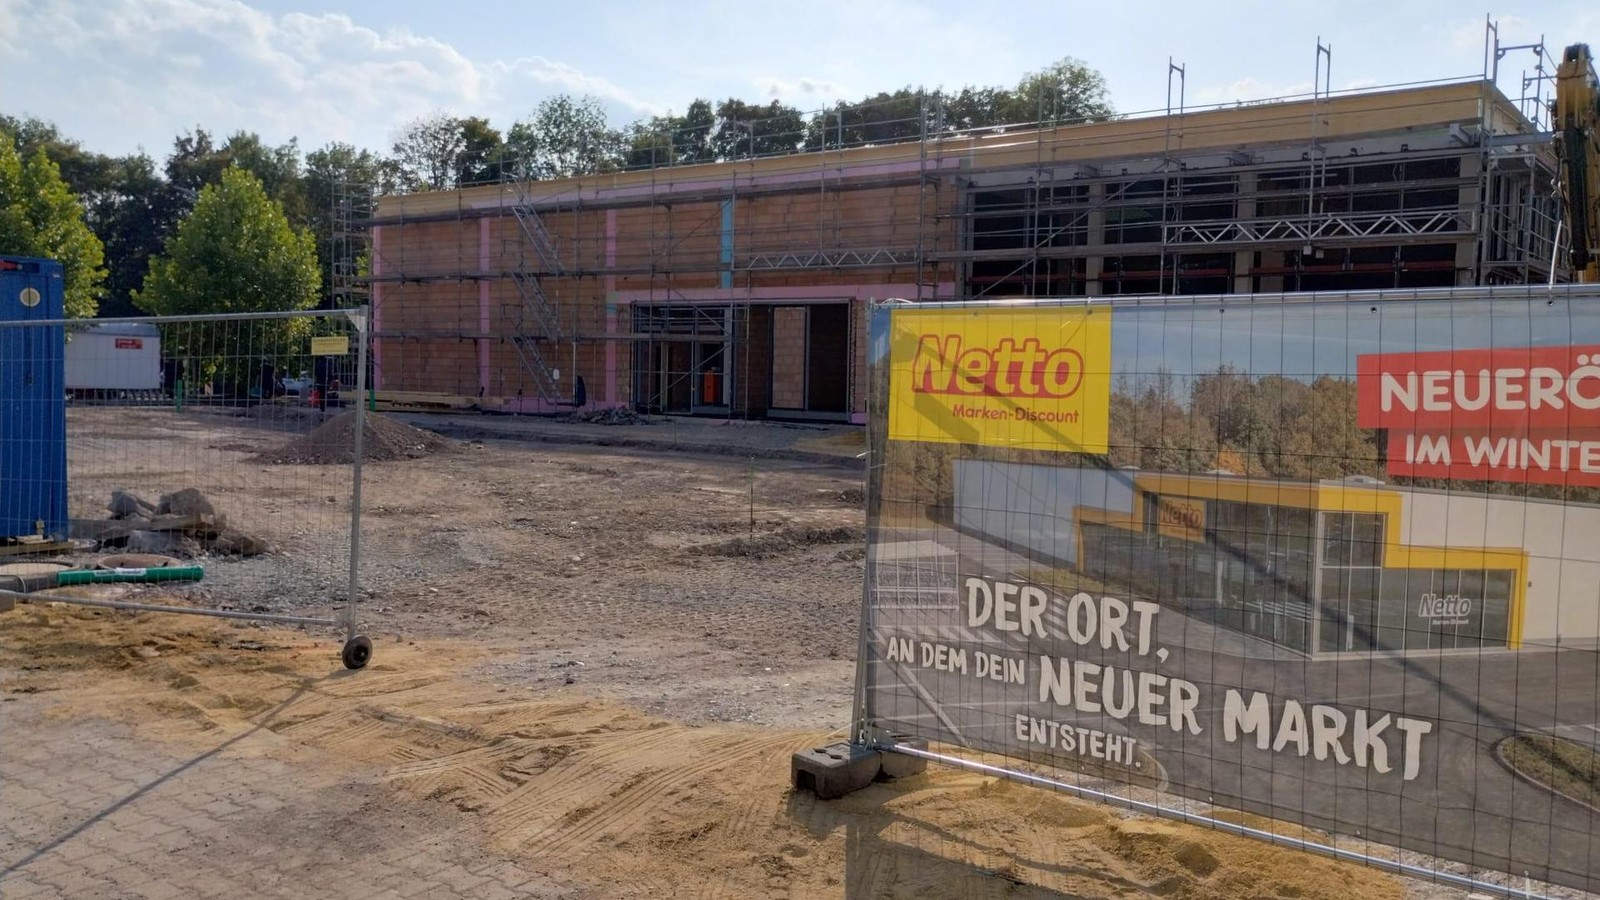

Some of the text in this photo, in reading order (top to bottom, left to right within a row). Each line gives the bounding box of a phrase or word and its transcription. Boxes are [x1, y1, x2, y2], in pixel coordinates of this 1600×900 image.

[912, 334, 1084, 399] Netto
[1381, 354, 1600, 412] NEUERÖ
[953, 403, 1080, 424] Marken-Discount
[1406, 434, 1600, 473] IM WINTE
[966, 577, 1170, 664] DER ORT,
[1418, 593, 1472, 617] Netto
[887, 637, 1432, 780] AN DEM DEIN NEUER MARKT
[1015, 713, 1141, 768] ENTSTEHT.
